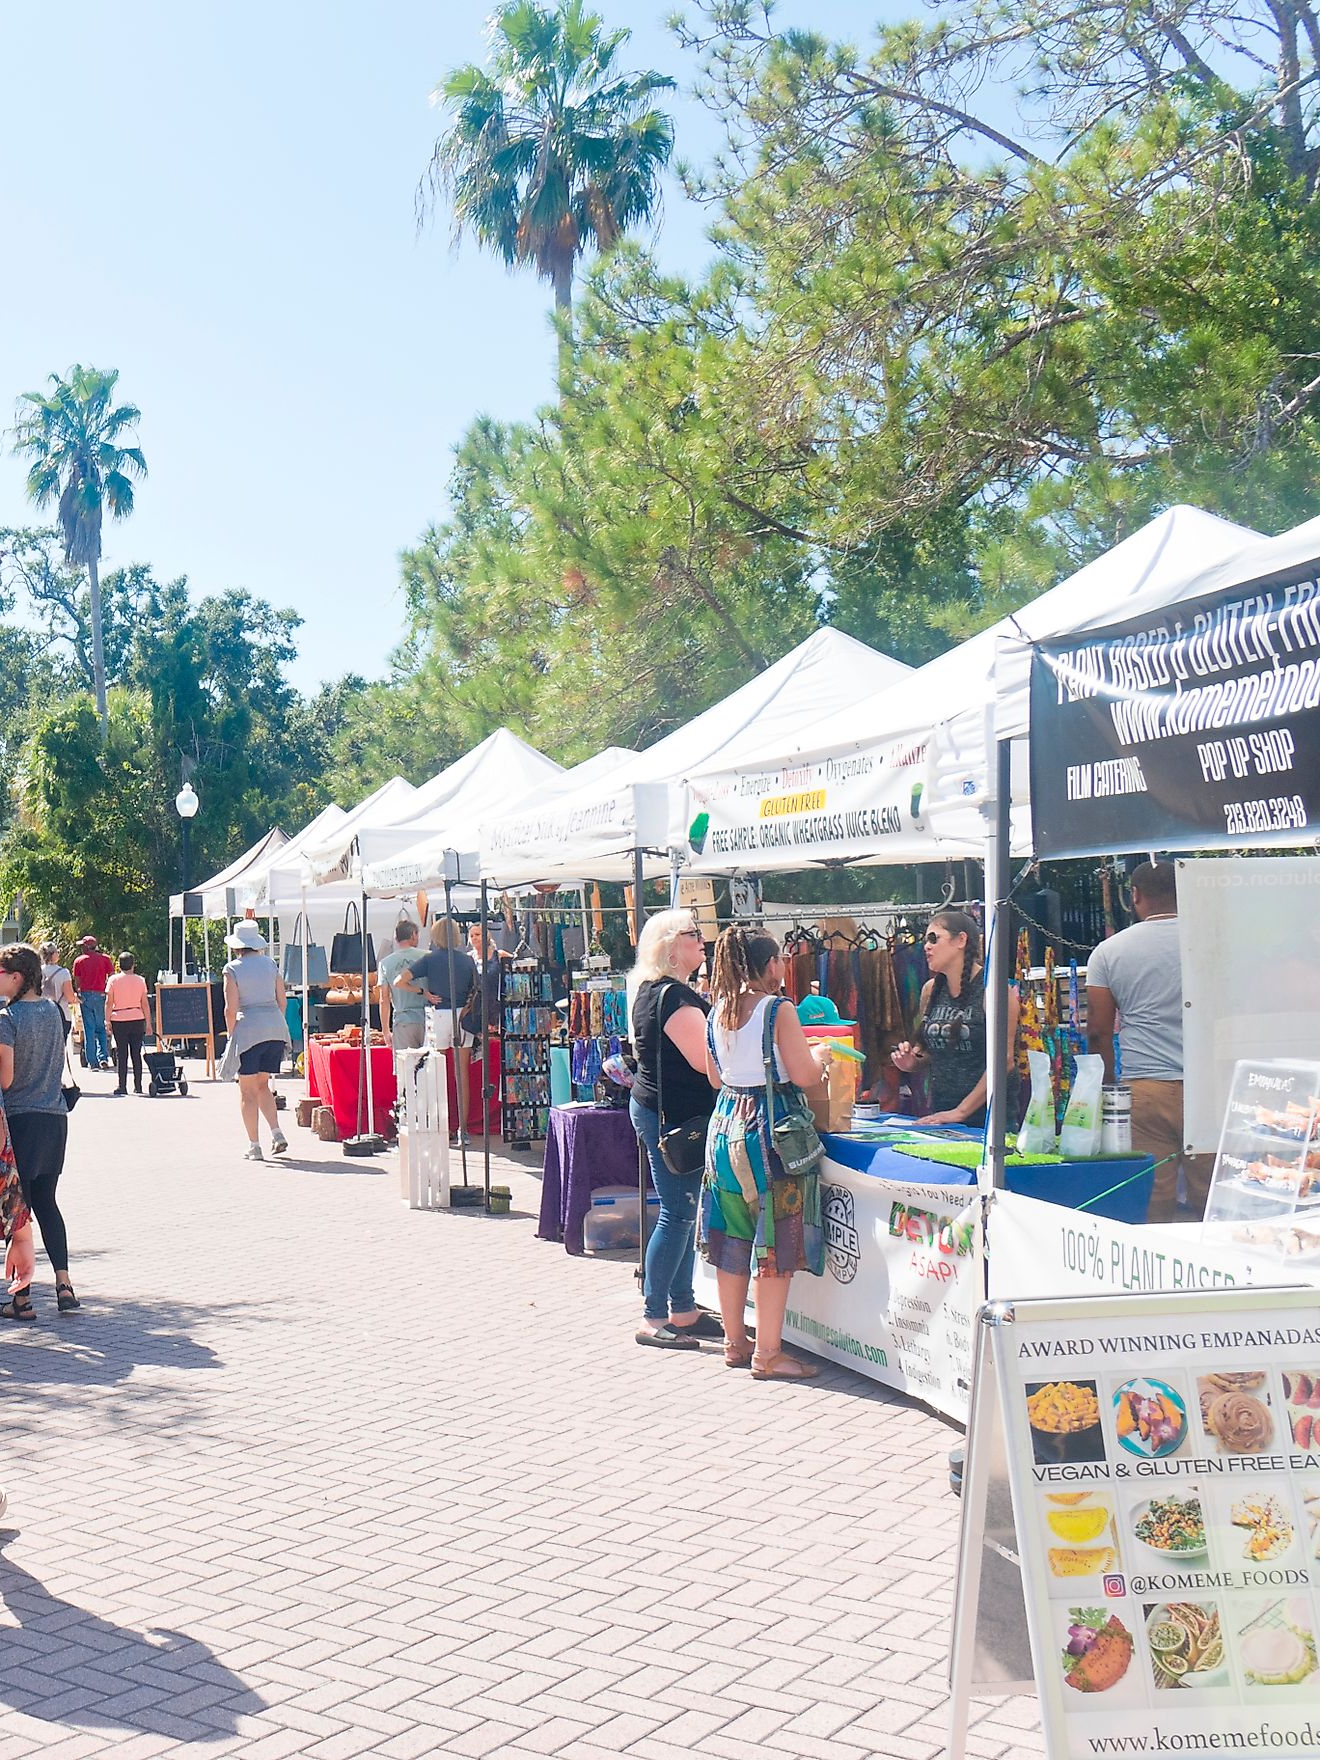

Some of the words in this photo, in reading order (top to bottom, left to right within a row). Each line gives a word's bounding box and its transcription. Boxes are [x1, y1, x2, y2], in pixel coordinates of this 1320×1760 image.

[1196, 740, 1228, 783] POP
[1227, 736, 1250, 779] UP
[1248, 728, 1296, 775] SHOP
[1066, 763, 1091, 801] FILM
[1093, 755, 1148, 798] CATERING
[763, 793, 798, 817] GLUTEN
[799, 791, 822, 811] FREE
[1223, 794, 1307, 835] 213.820.3248
[712, 830, 728, 852] FREE
[759, 821, 792, 848] ORGANIC
[793, 813, 845, 844] WHEATGRASS
[846, 809, 868, 839] JUICE
[870, 805, 902, 835] BLEND
[940, 1190, 964, 1207] Need
[889, 1200, 974, 1260] DETOX
[910, 1251, 959, 1286] ASAP!
[1061, 1227, 1104, 1281] 100%
[1111, 1239, 1166, 1292] PLANT
[1018, 1338, 1094, 1358] AWARD
[1097, 1333, 1196, 1354] WINNING
[1201, 1327, 1320, 1349] EMPANADAS
[1032, 1463, 1110, 1483] VEGAN
[1115, 1462, 1130, 1478] &
[1136, 1458, 1224, 1477] GLUTEN
[1228, 1455, 1285, 1473] FREE
[1289, 1453, 1320, 1469] EA
[1130, 1568, 1309, 1595] @KOMEME_FOODS
[1088, 1722, 1320, 1753] www.komemefoods
